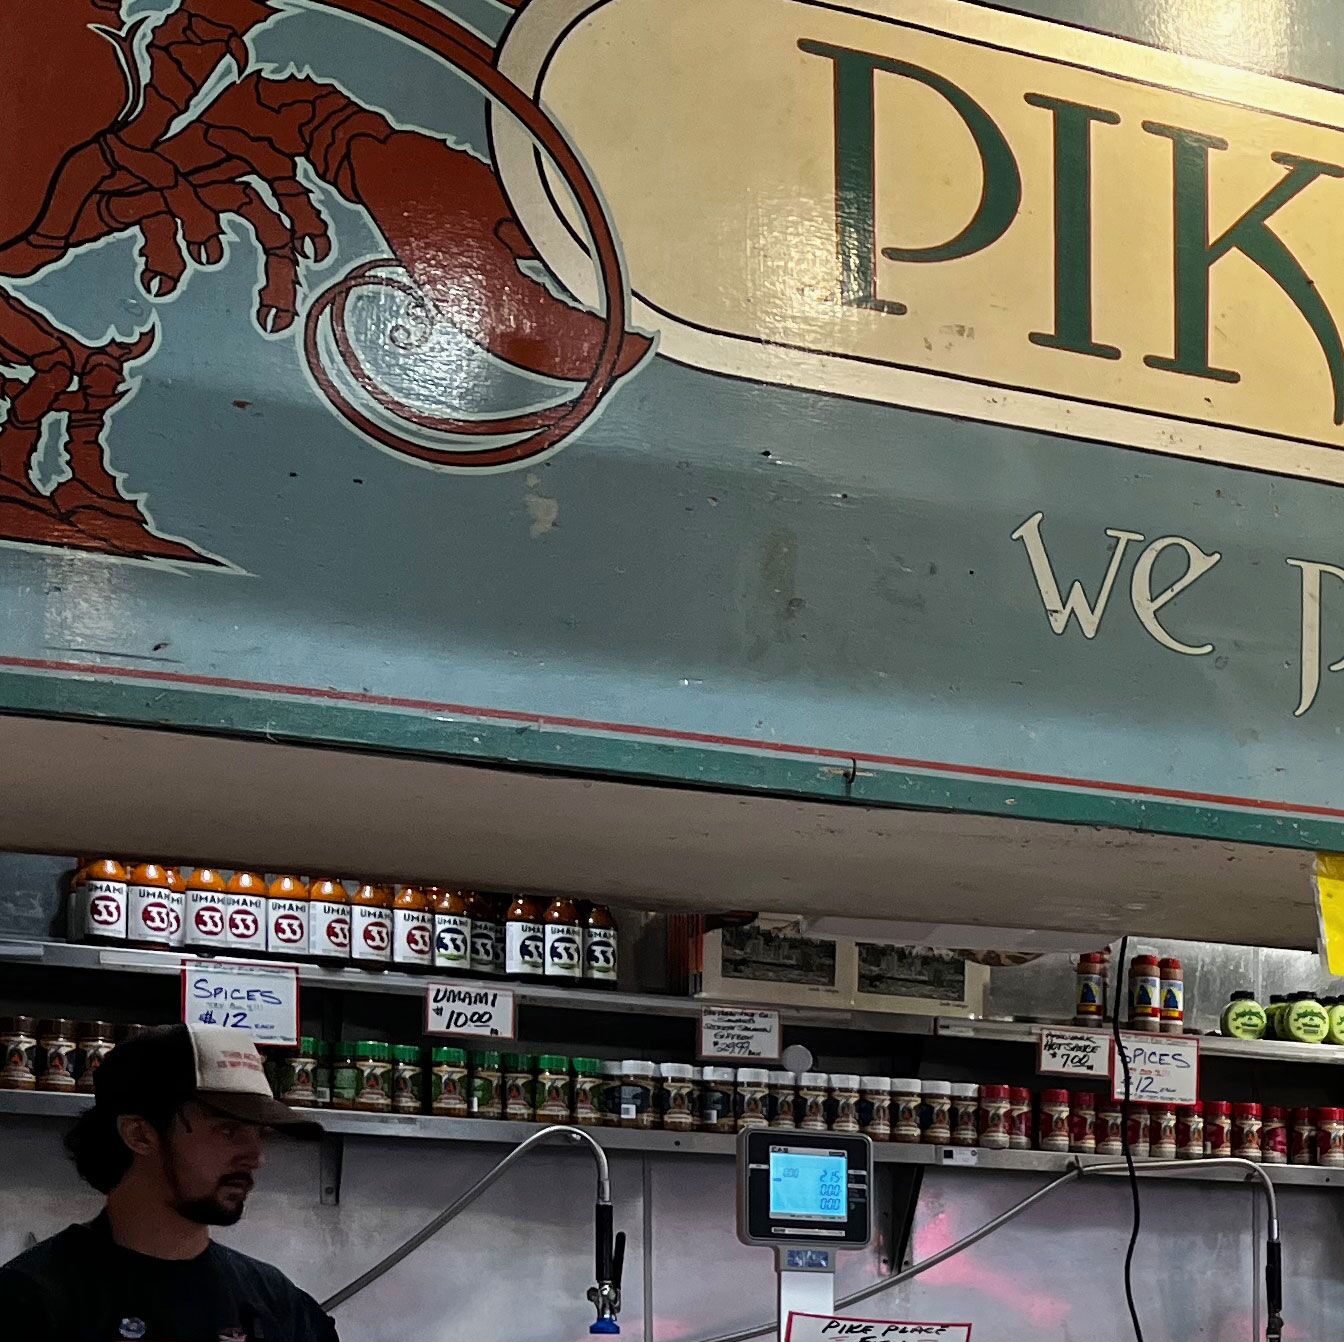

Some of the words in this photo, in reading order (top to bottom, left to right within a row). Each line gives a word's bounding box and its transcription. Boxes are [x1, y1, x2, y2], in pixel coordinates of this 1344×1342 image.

[193, 979, 282, 1005] SPICES
[433, 987, 498, 1007] UMAMI
[199, 1012, 251, 1029] $12
[821, 1320, 875, 1335] PIKE
[881, 1324, 949, 1337] PLACE
